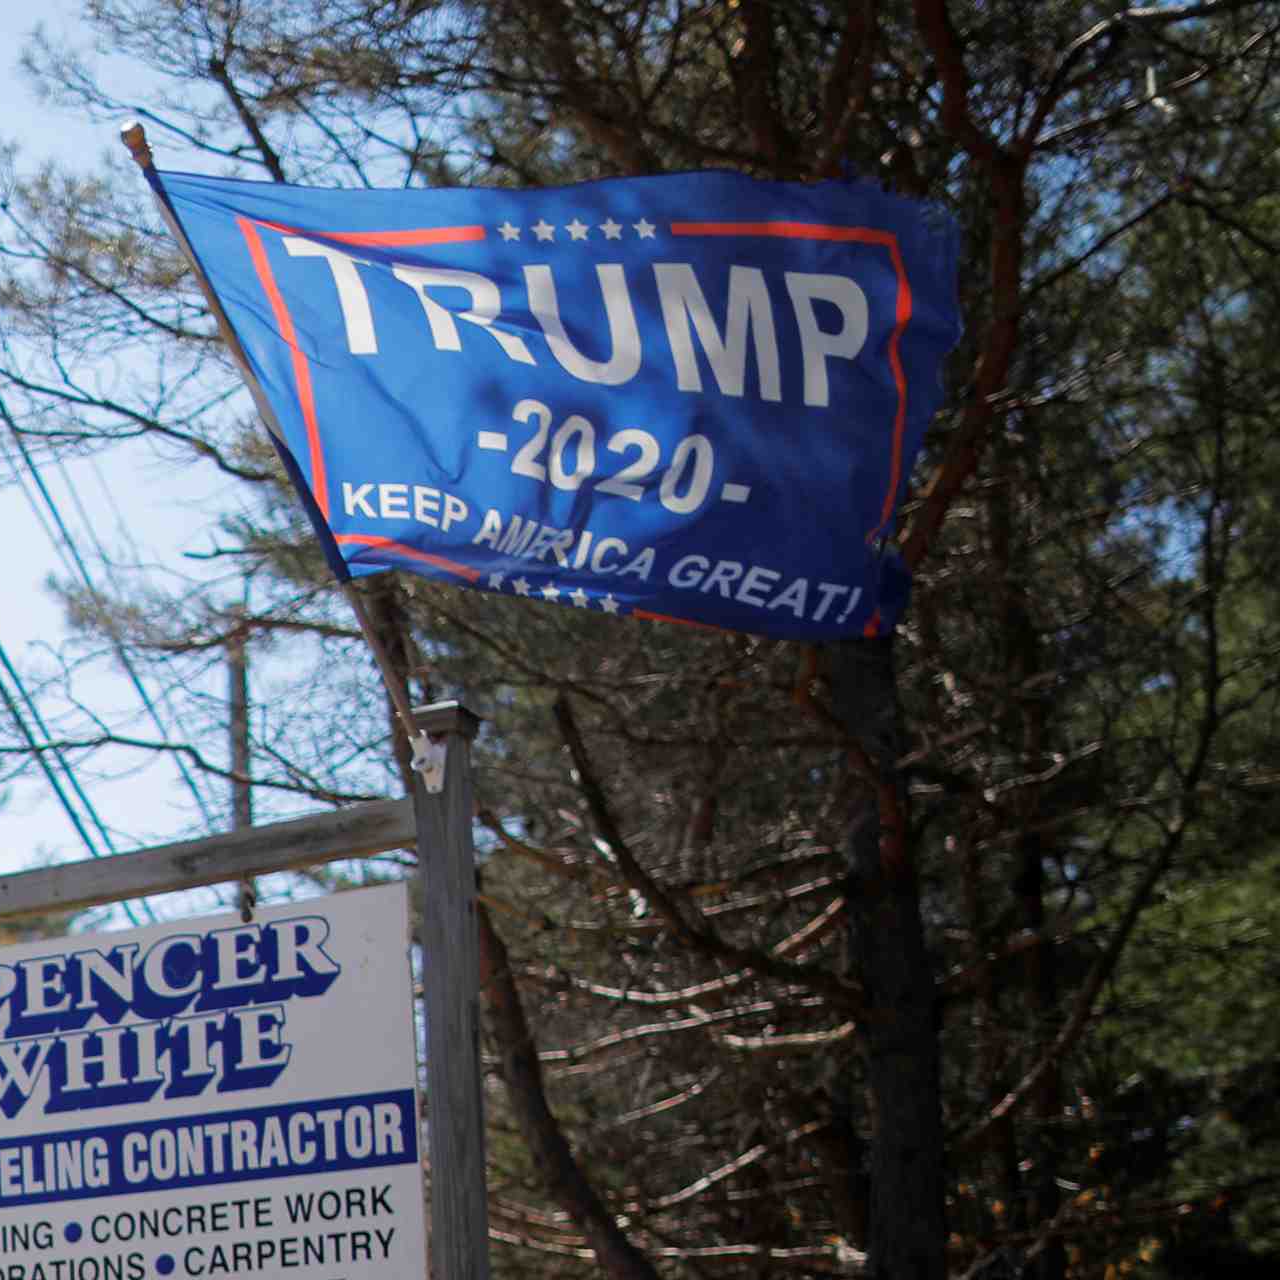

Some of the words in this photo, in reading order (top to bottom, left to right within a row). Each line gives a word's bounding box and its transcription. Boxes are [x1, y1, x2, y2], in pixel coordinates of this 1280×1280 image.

[282, 235, 870, 407] TRUMP
[342, 481, 468, 533] KEEP
[473, 508, 653, 582] AMERICA
[668, 553, 863, 625] GREAT!
[122, 1102, 404, 1185] CONTRACTOR
[90, 1197, 274, 1244] CONCRETE
[284, 1184, 395, 1225] WORK
[184, 1228, 396, 1277] CARPENTRY
